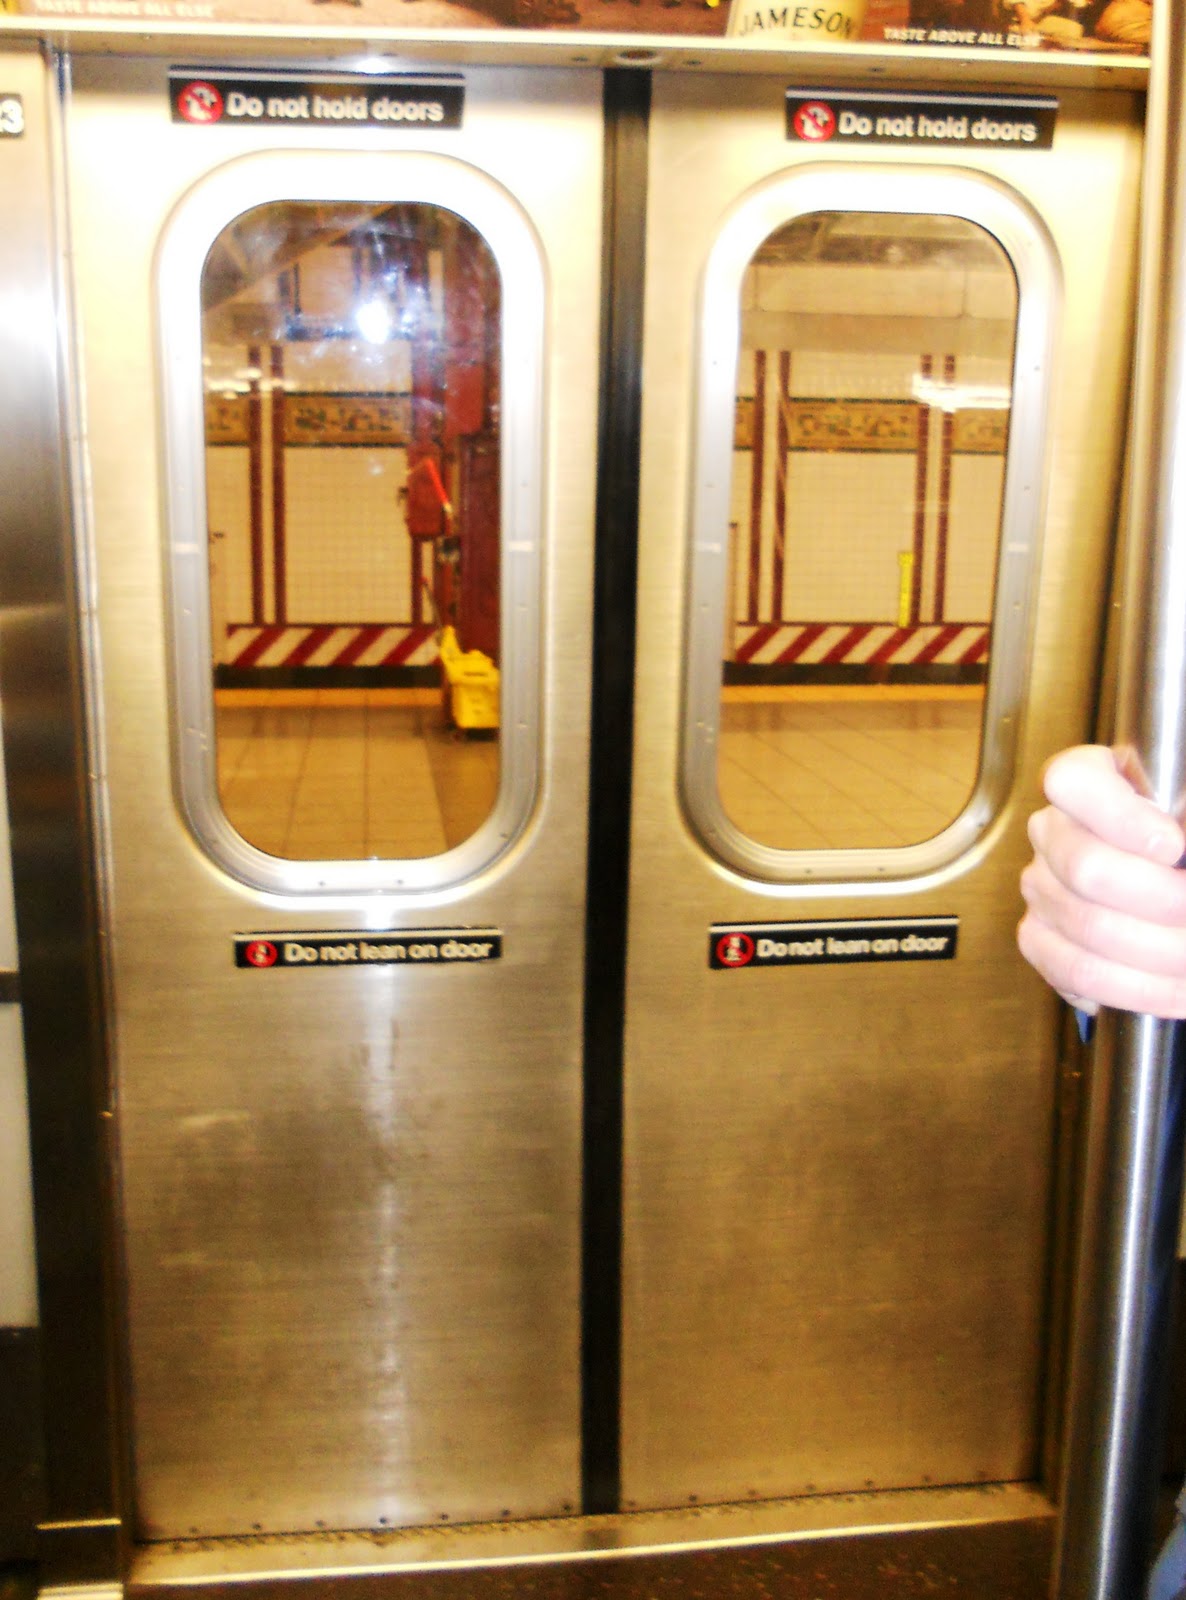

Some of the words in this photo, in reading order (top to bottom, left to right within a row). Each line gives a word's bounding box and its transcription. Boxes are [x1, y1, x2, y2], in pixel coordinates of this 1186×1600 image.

[884, 27, 926, 41] TASTE
[927, 29, 977, 43] ABOVE
[978, 32, 1004, 45] ALL
[226, 92, 264, 117] Do
[267, 96, 309, 118] not
[313, 95, 368, 119] hold
[371, 97, 444, 121] doors
[838, 111, 872, 135] Do
[876, 115, 914, 137] not
[917, 114, 968, 139] hold
[971, 117, 1037, 142] doors
[284, 943, 318, 962] Do
[320, 942, 357, 961] not
[359, 941, 406, 960] lean
[408, 942, 438, 959] on
[440, 939, 493, 958] door
[757, 939, 787, 957] Do
[788, 938, 824, 957] not
[826, 937, 870, 954] lean
[872, 937, 899, 953] on
[900, 934, 948, 951] door
